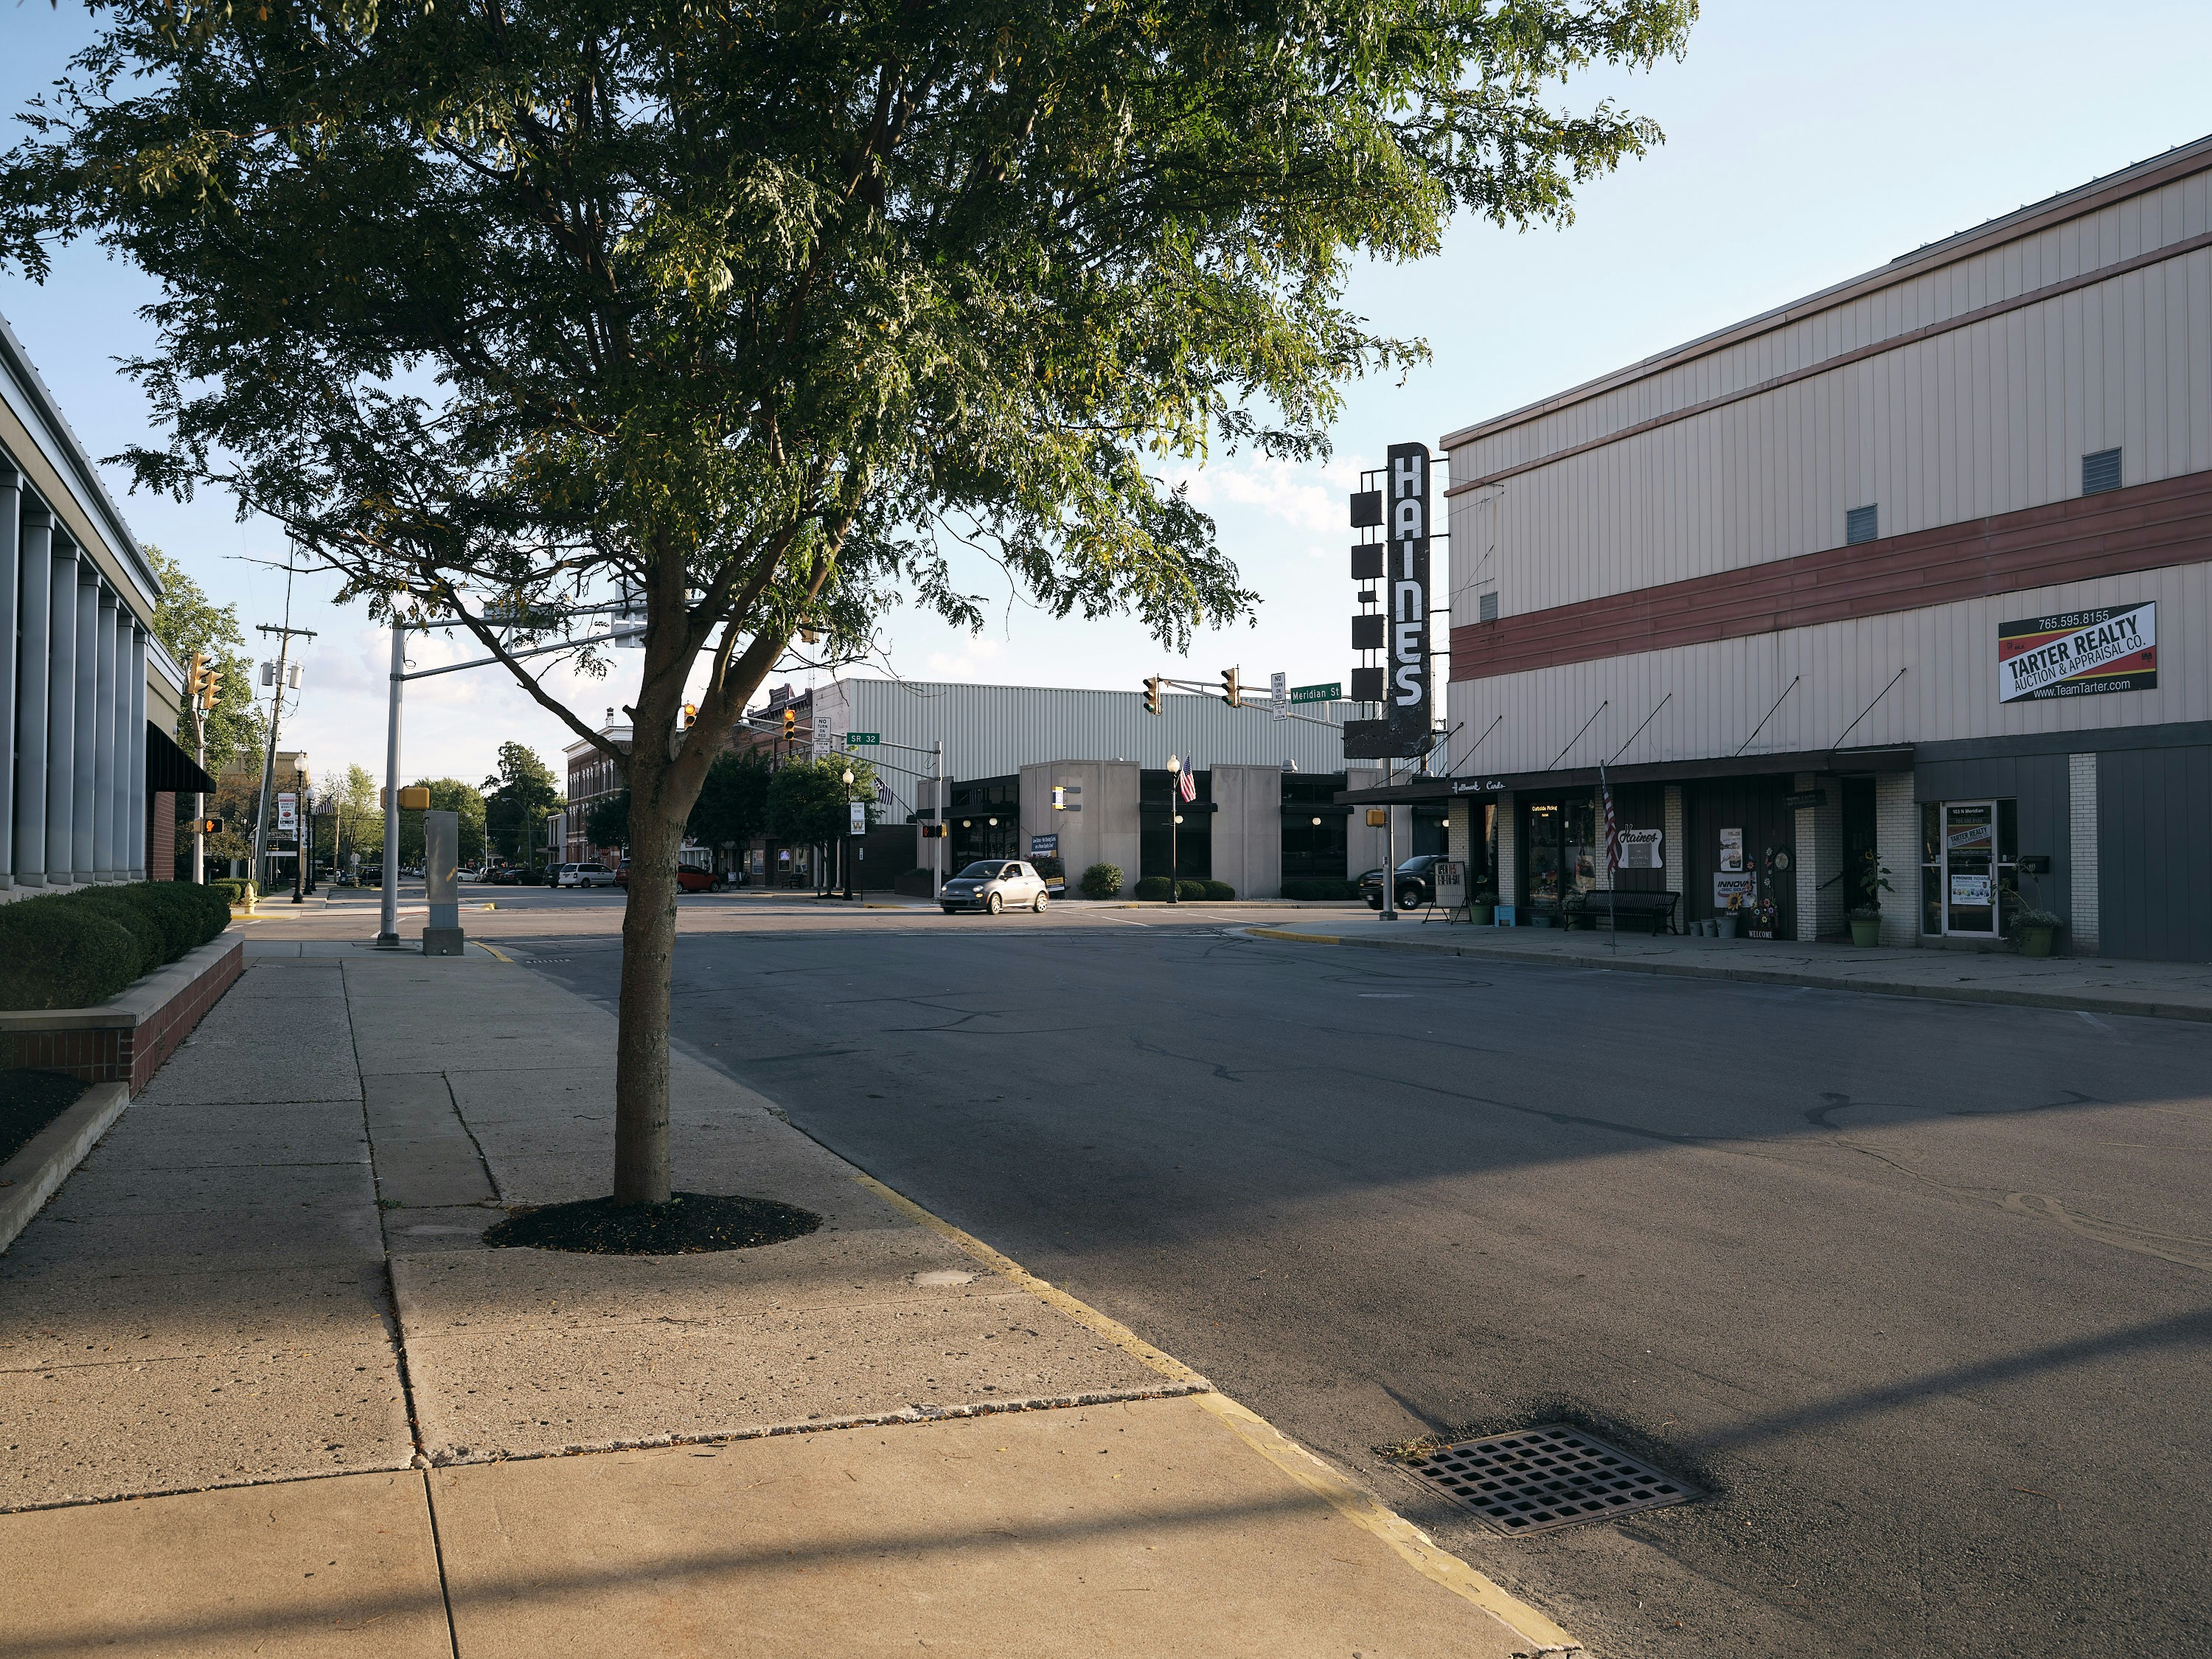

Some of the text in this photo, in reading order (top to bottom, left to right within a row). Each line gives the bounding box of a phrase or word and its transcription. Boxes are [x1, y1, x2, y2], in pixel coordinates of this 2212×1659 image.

[1395, 455, 1422, 706] HAINES
[2039, 610, 2109, 630] 765.595.8155
[2008, 614, 2137, 680] TARTER REALTY
[2015, 635, 2146, 692] AUCTION & APPRAISAL CO.
[1293, 686, 1339, 700] Meridian St
[2034, 680, 2130, 698] www.TeamTarter.com
[1452, 781, 1506, 794] Hallmark Cards
[1619, 824, 1658, 843] Haines
[1951, 827, 1987, 842] TARTER REALTY
[1438, 864, 1448, 874] OPEN
[1748, 930, 1773, 939] WELCOME
